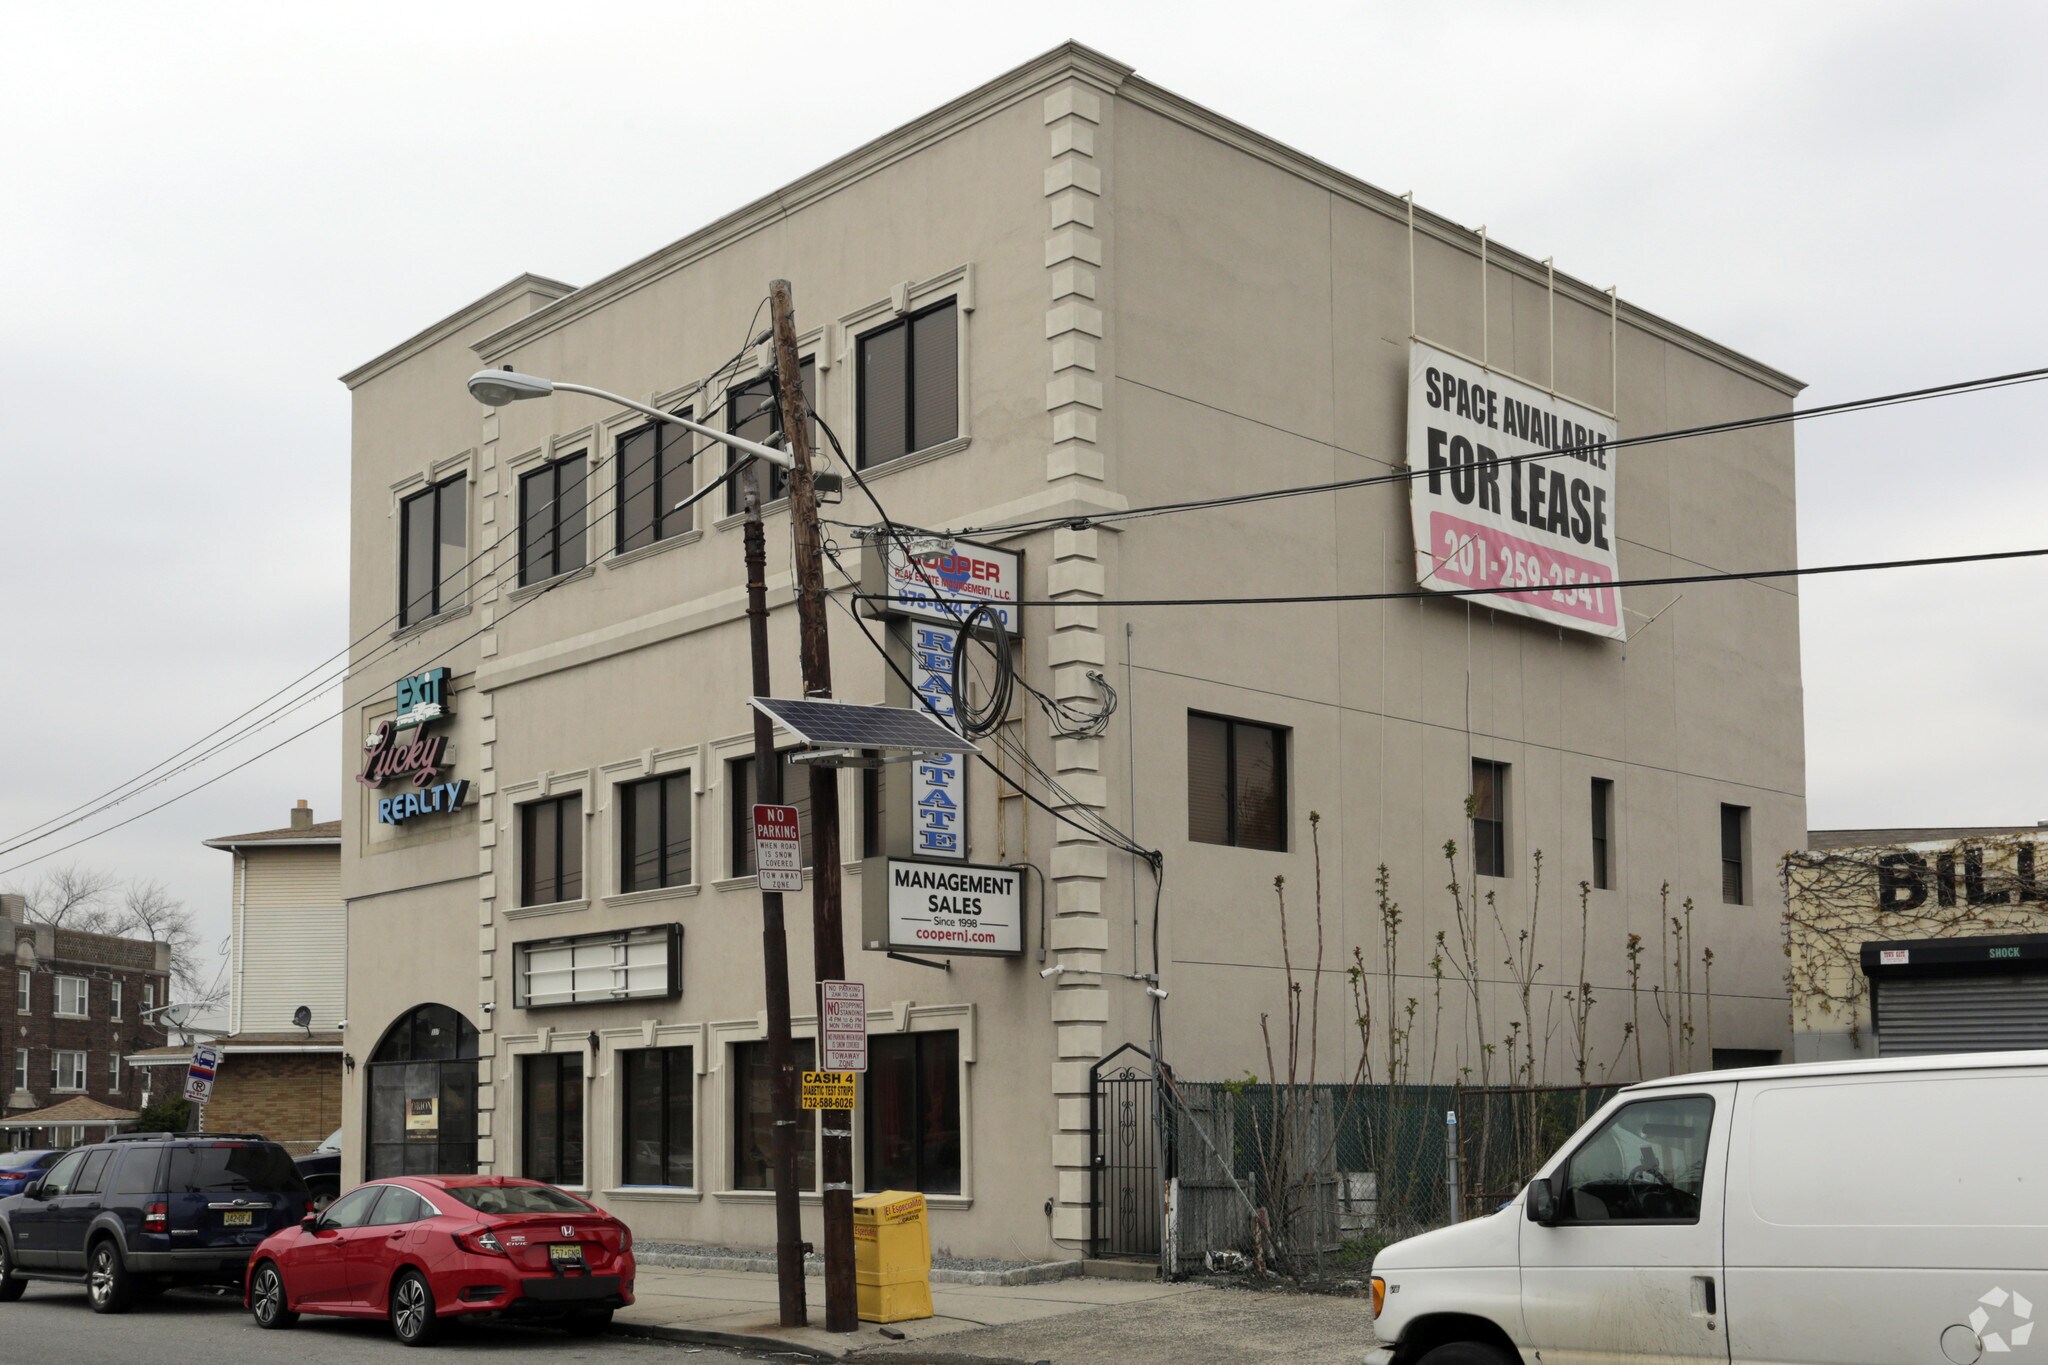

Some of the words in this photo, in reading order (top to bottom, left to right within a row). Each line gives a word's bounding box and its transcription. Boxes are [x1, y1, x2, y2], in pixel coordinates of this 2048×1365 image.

[1425, 366, 1498, 429] SPACE
[1503, 396, 1607, 471] AVAILABLE
[1427, 426, 1501, 515] FOR
[1510, 456, 1610, 551] LEASE
[1444, 529, 1604, 614] 201-259-2541
[356, 721, 441, 789] Lucky
[379, 780, 462, 825] REALTY
[767, 809, 784, 822] NO
[757, 824, 796, 839] PARKING
[765, 859, 793, 867] COVERED
[762, 871, 776, 879] TOW
[780, 872, 798, 880] AWAY
[773, 880, 789, 888] ZONE
[895, 869, 1013, 896] MANAGEMENT
[928, 894, 982, 916] SALES
[933, 916, 956, 927] Since
[958, 918, 978, 928] 1998
[916, 928, 995, 943] coopernj.com
[1989, 947, 2021, 959] SHOCK
[839, 985, 861, 993] PARKING
[827, 1001, 840, 1015] NO
[840, 1009, 863, 1017] STANDING
[832, 1052, 860, 1060] TOWAWAY
[838, 1060, 855, 1068] ZONE
[803, 1073, 841, 1084] CASH
[845, 1073, 854, 1084] 4
[803, 1085, 824, 1096] DIABETIC
[825, 1085, 837, 1096] TEST
[837, 1085, 854, 1097] STRIPS
[803, 1097, 854, 1109] 732-588-6026
